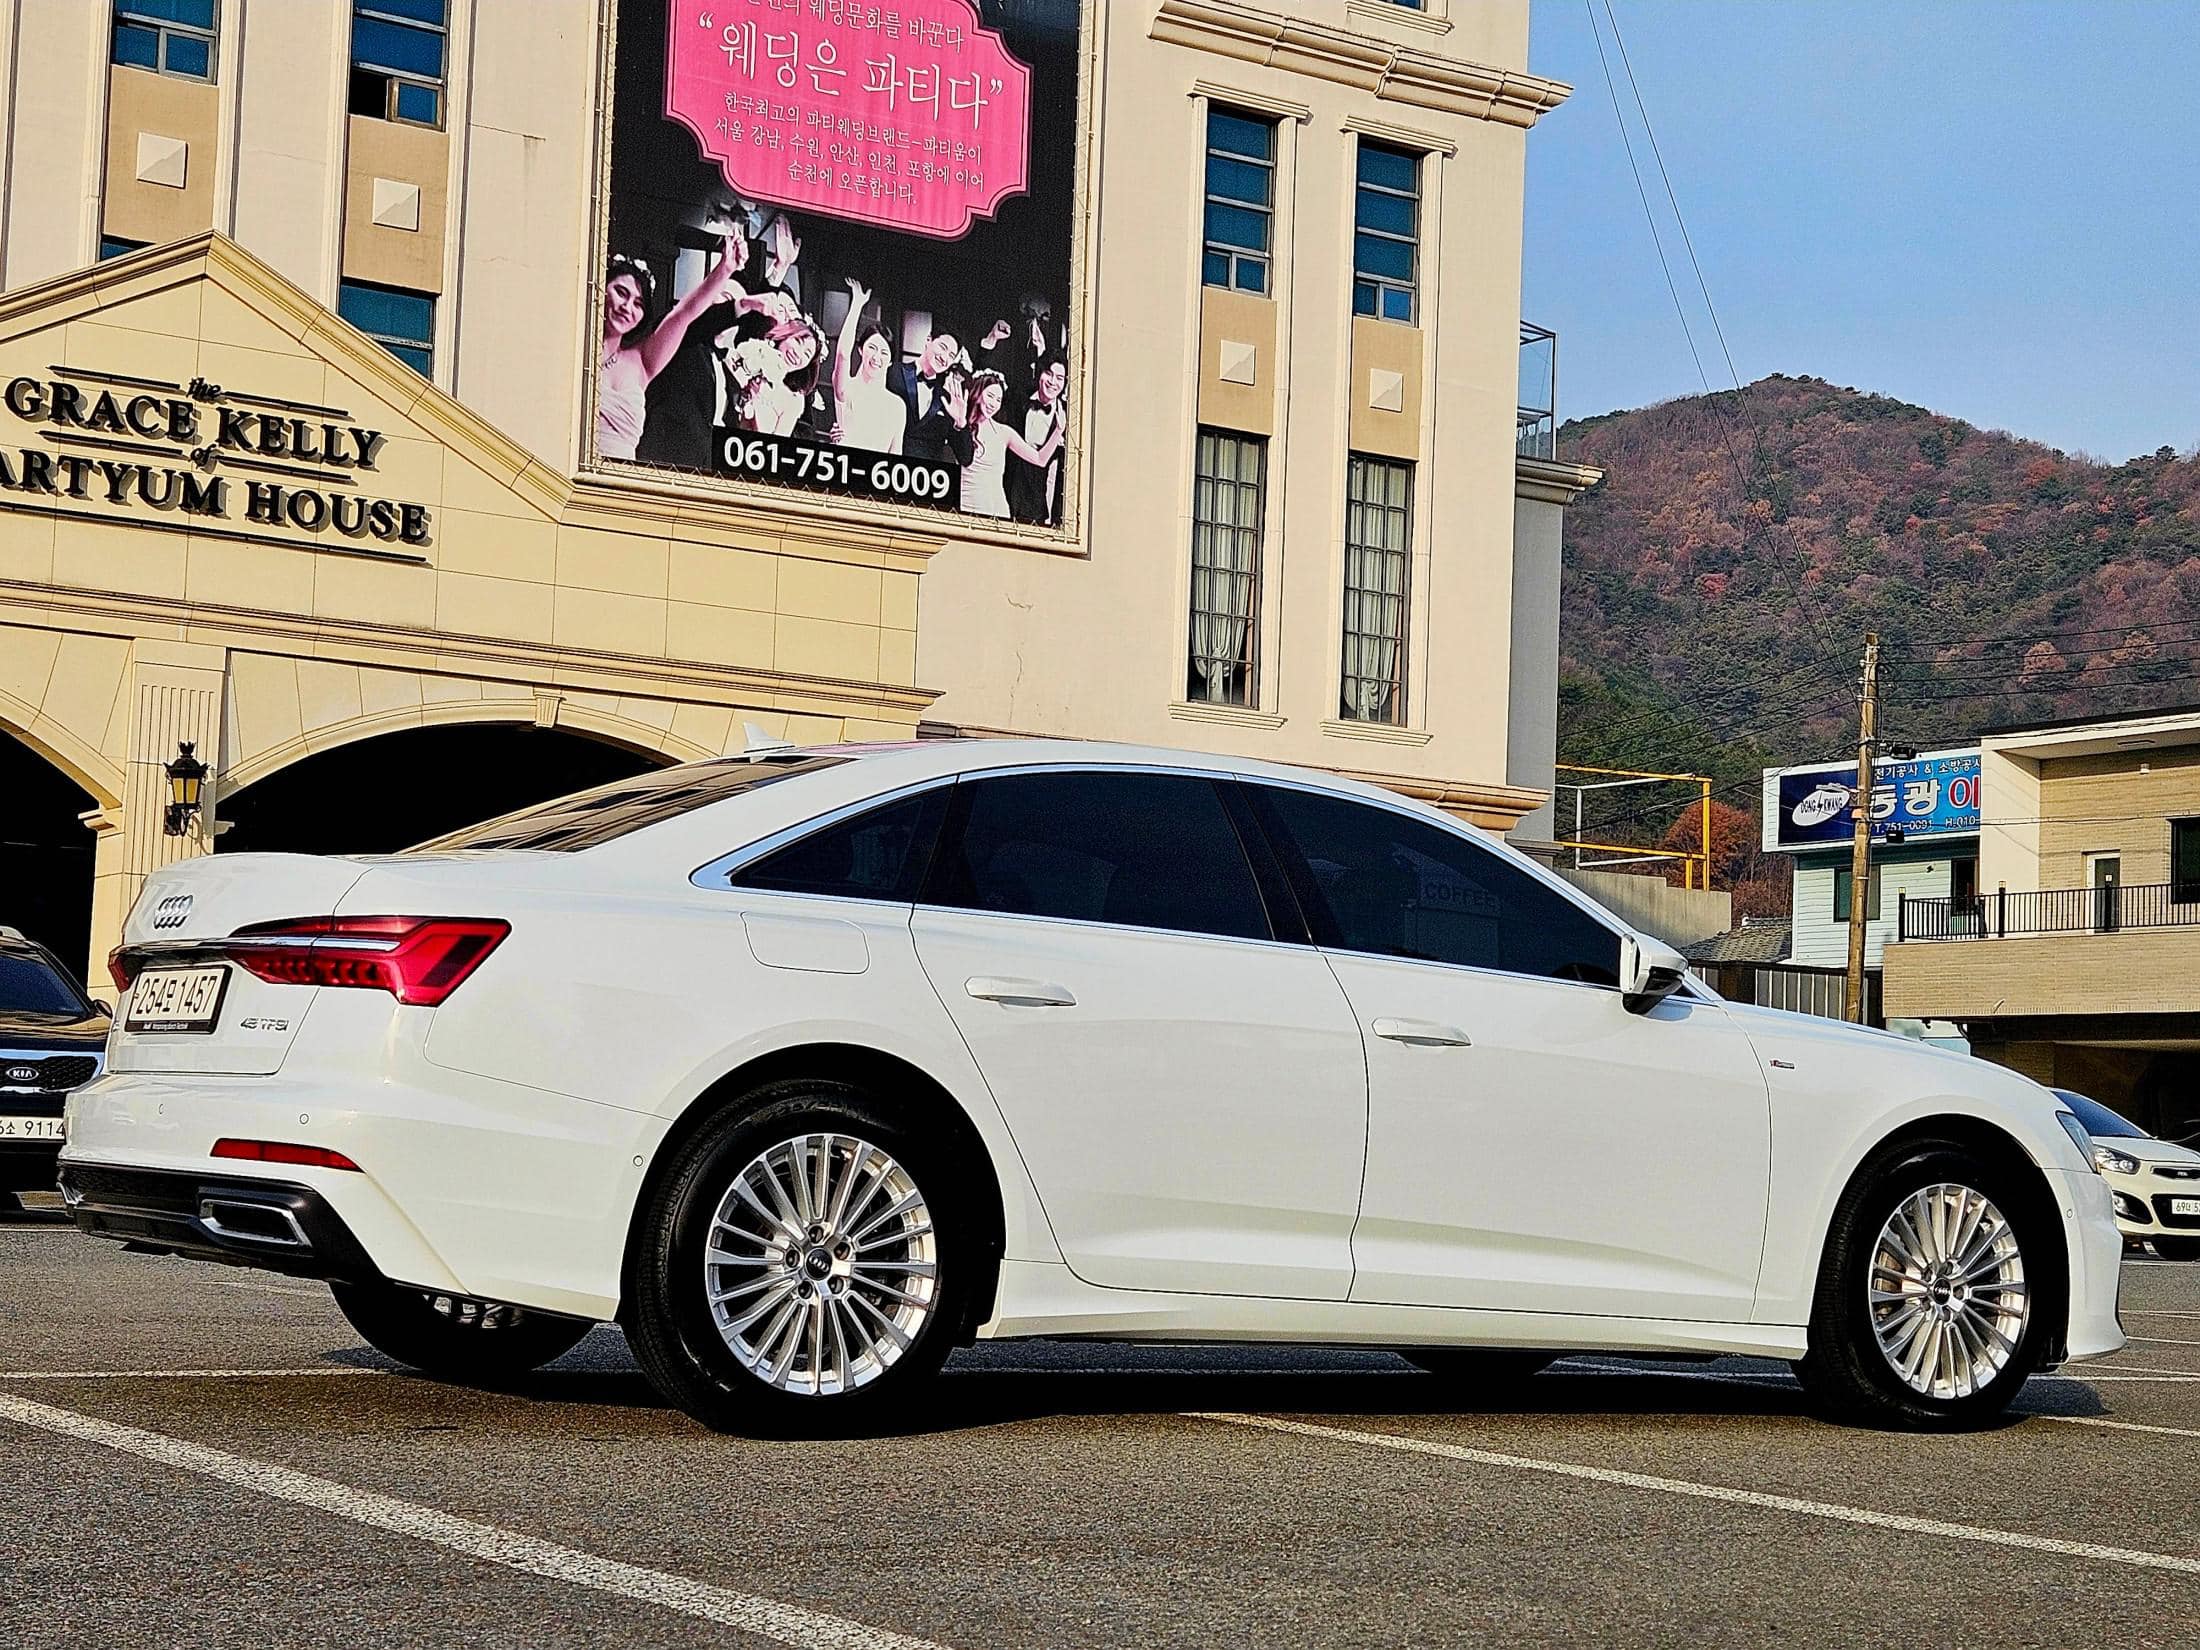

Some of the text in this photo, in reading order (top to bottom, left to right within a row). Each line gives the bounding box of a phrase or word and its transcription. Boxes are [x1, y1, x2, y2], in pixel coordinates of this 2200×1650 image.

[908, 17, 964, 53] 바꾼다
[724, 92, 801, 127] 한국최고의
[714, 118, 985, 192] 서울 강남, 수원, 안산, 인천, 포항에 이어
[786, 162, 917, 205] 순천에 오픈합니다.
[188, 376, 222, 399] the
[4, 376, 382, 469] GRACE KELLY
[189, 443, 218, 469] of
[723, 436, 951, 498] 061-751-6009
[243, 480, 427, 543] HOUSE
[1924, 763, 1932, 775] &
[177, 975, 218, 1014] 1457
[12, 1069, 33, 1078] KIA
[24, 1120, 65, 1137] 9114
